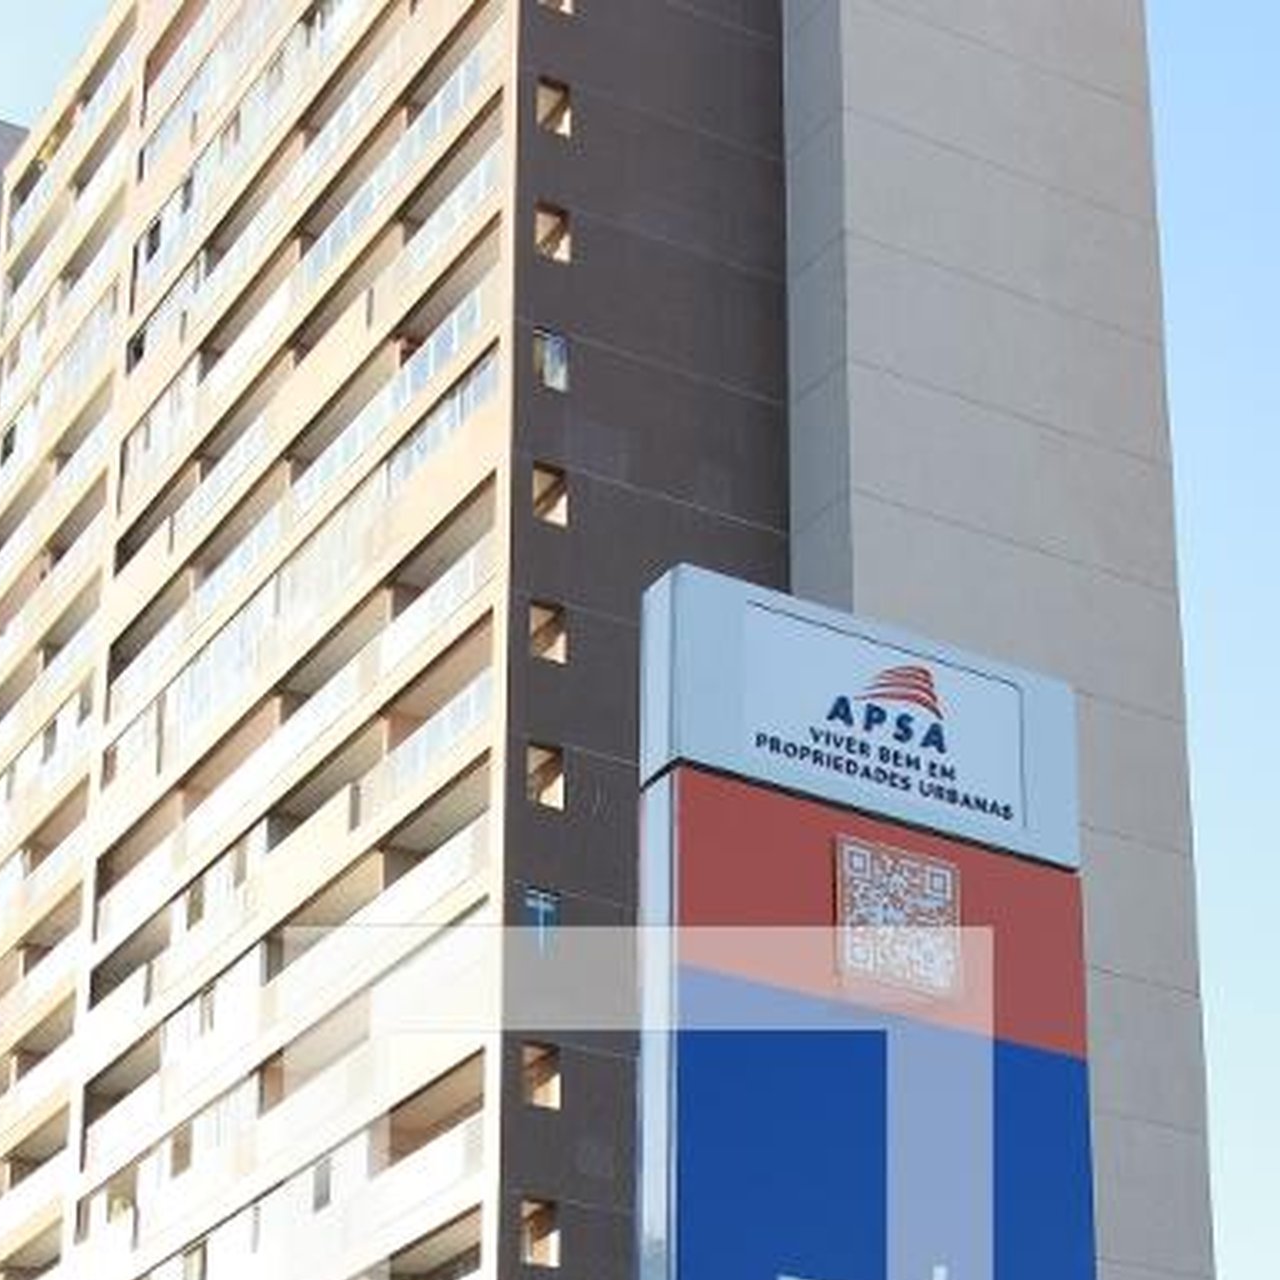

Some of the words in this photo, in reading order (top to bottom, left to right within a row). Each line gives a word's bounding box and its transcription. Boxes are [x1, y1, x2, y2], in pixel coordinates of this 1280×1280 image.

[810, 726, 871, 759] VIVER
[878, 746, 921, 772] BEM
[928, 761, 955, 781] EM
[826, 695, 947, 754] APSA
[755, 731, 911, 791] PROPRIEDADES
[919, 779, 1014, 821] URBANAS
